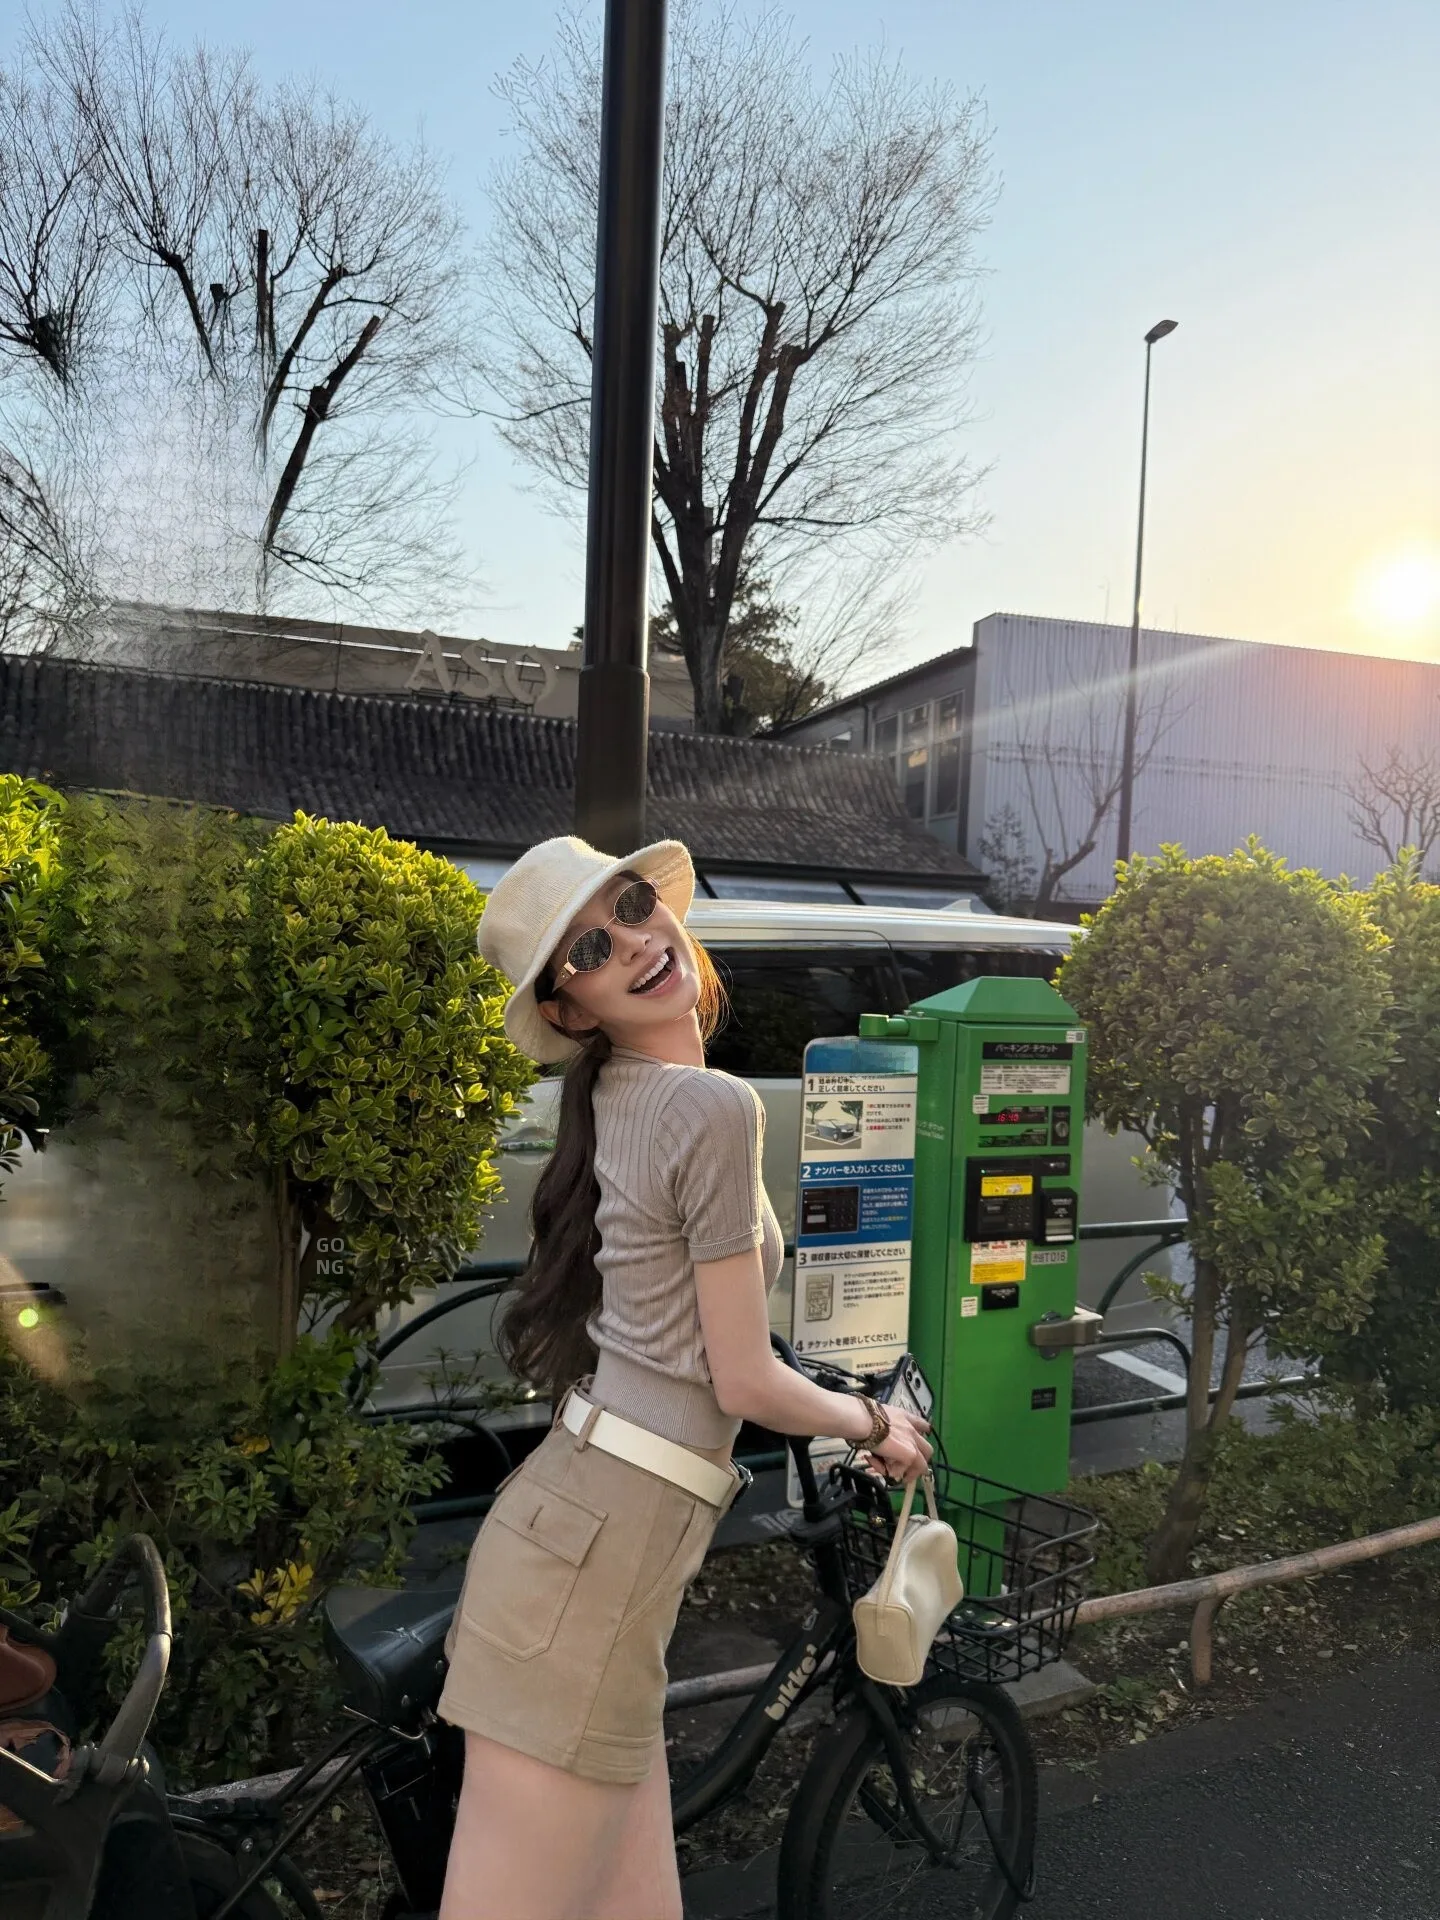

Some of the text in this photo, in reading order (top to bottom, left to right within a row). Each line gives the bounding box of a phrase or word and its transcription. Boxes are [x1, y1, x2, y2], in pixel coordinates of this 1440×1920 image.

[808, 1079, 814, 1091] 1
[802, 1164, 905, 1178] 2 ナンバーを入力してください
[799, 1252, 807, 1265] 3
[795, 1332, 897, 1352] 4 チケットを掲示してください
